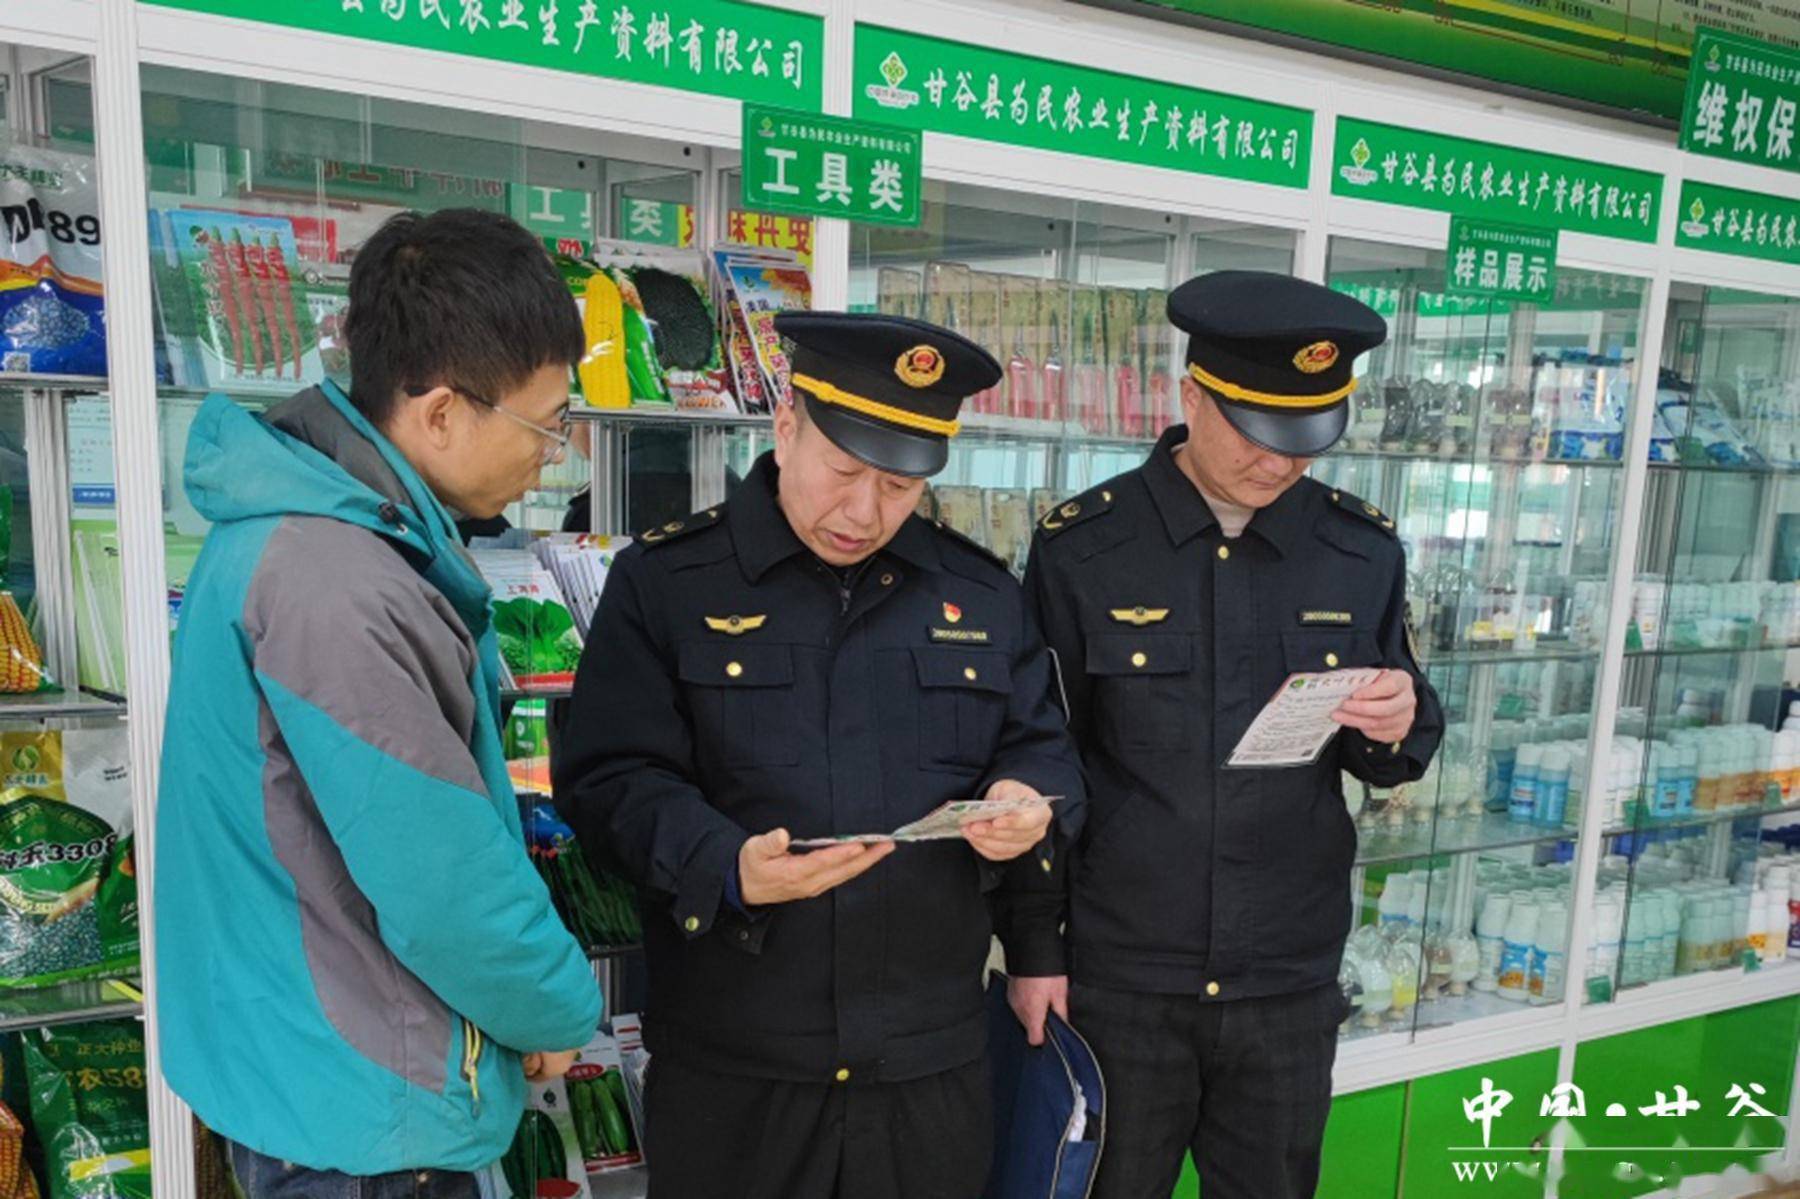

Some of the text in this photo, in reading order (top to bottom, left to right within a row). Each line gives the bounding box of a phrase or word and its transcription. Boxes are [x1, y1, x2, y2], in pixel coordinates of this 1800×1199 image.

[923, 67, 1299, 169] 甘谷县为民农业生产资料有限公司
[761, 147, 904, 213] 工具类
[1381, 150, 1652, 227] 甘谷县为民农业生产资料有限公司
[1453, 244, 1550, 293] 样品展示
